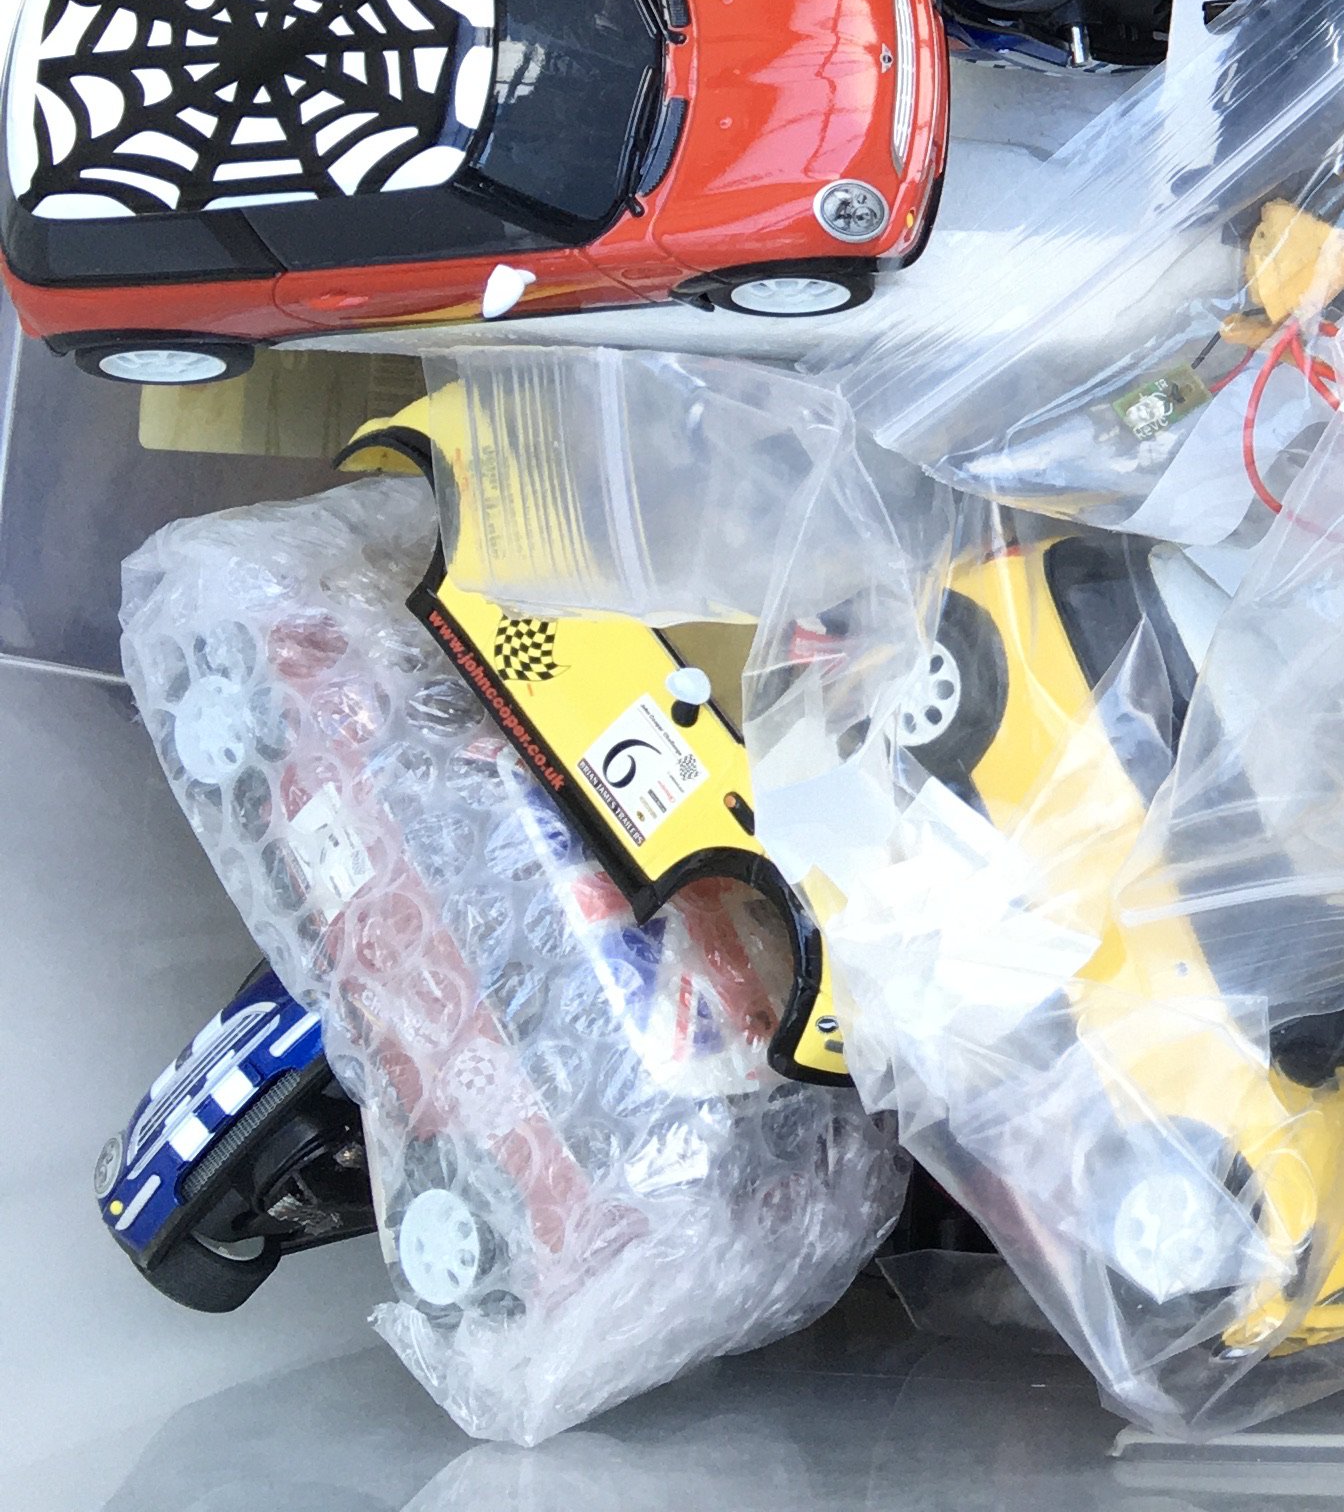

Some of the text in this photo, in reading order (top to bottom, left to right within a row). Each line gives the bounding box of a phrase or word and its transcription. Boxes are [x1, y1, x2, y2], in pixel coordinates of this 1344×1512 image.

[428, 610, 568, 791] www.johncooper.co.uk
[577, 760, 643, 845] BRIAN JAMES TRAILERS
[602, 738, 662, 788] 6
